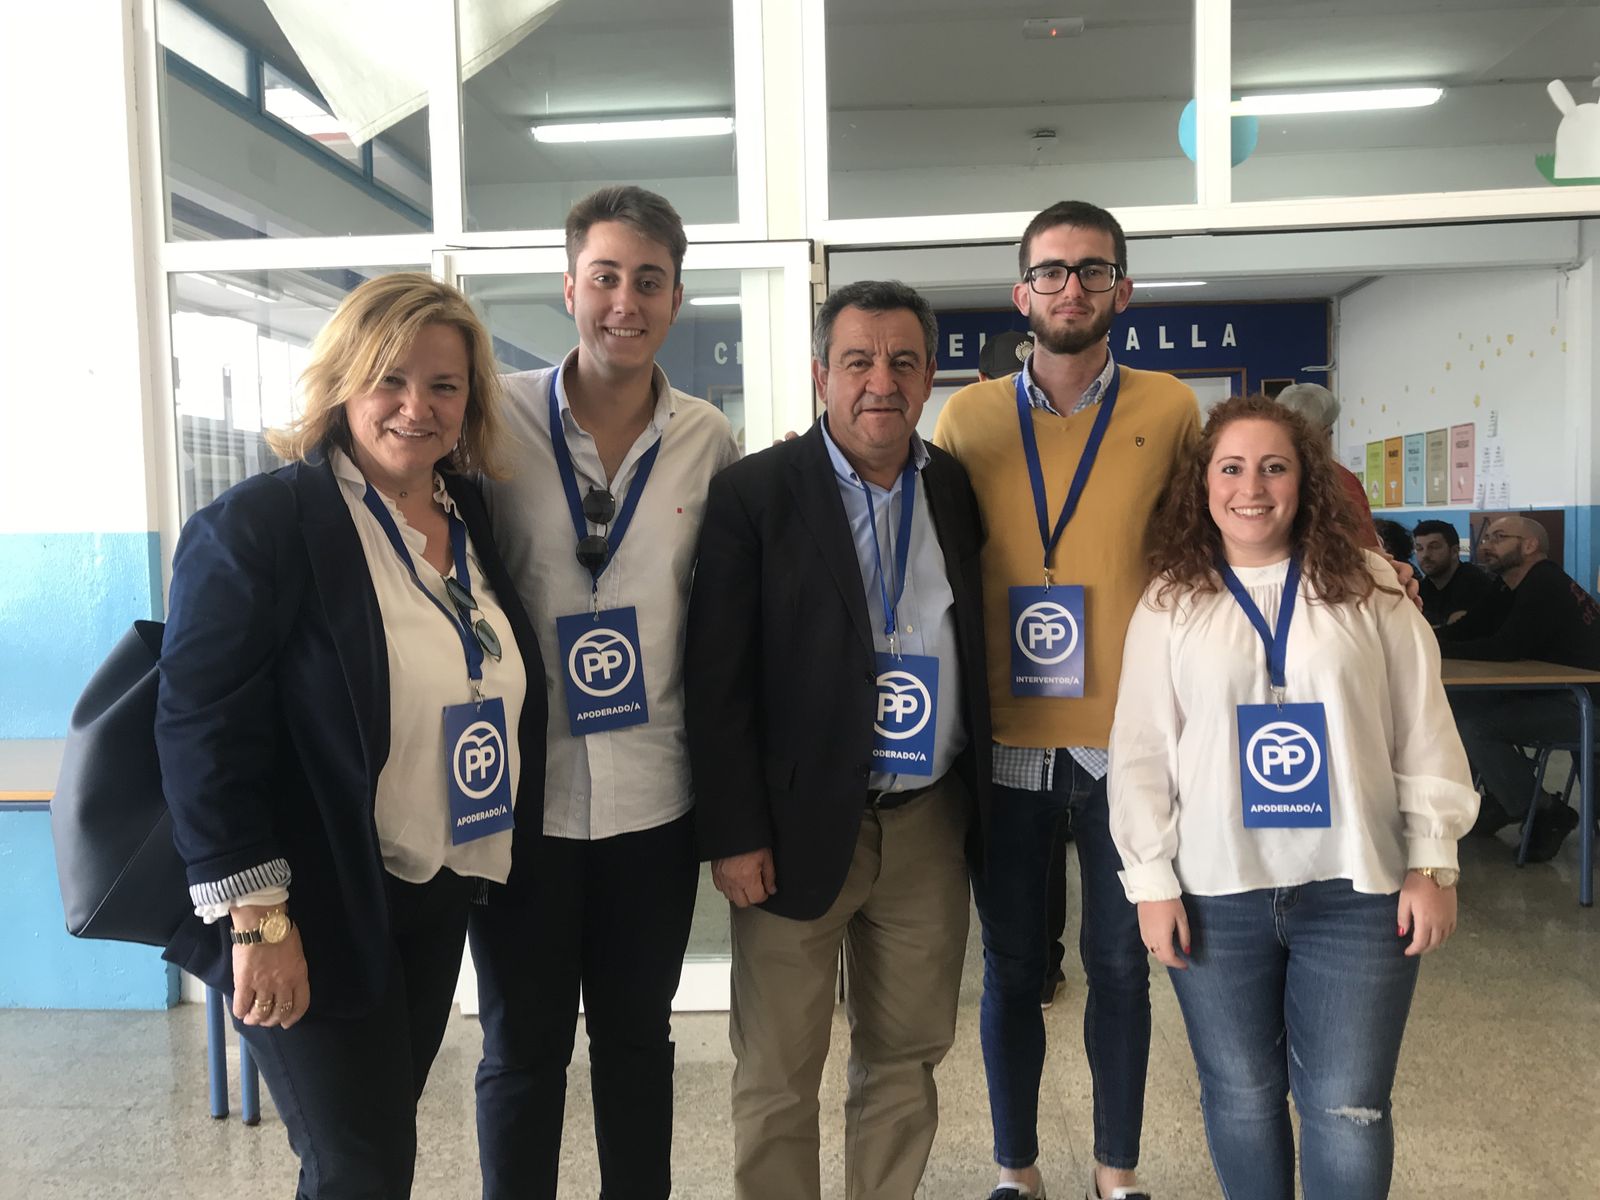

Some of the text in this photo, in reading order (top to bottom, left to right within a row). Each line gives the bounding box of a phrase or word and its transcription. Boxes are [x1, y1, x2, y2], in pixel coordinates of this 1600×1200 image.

[1107, 323, 1237, 351] ALLA
[1028, 622, 1066, 650] PP
[582, 648, 623, 683] PP
[1016, 675, 1080, 686] INTERVENTOR/A
[576, 700, 641, 721] APODERADO/A
[876, 692, 918, 723] PP
[465, 745, 496, 784] PP
[1261, 745, 1306, 776] PP
[456, 803, 508, 828] APODERADO/A
[1250, 802, 1323, 814] APODERADO/A
